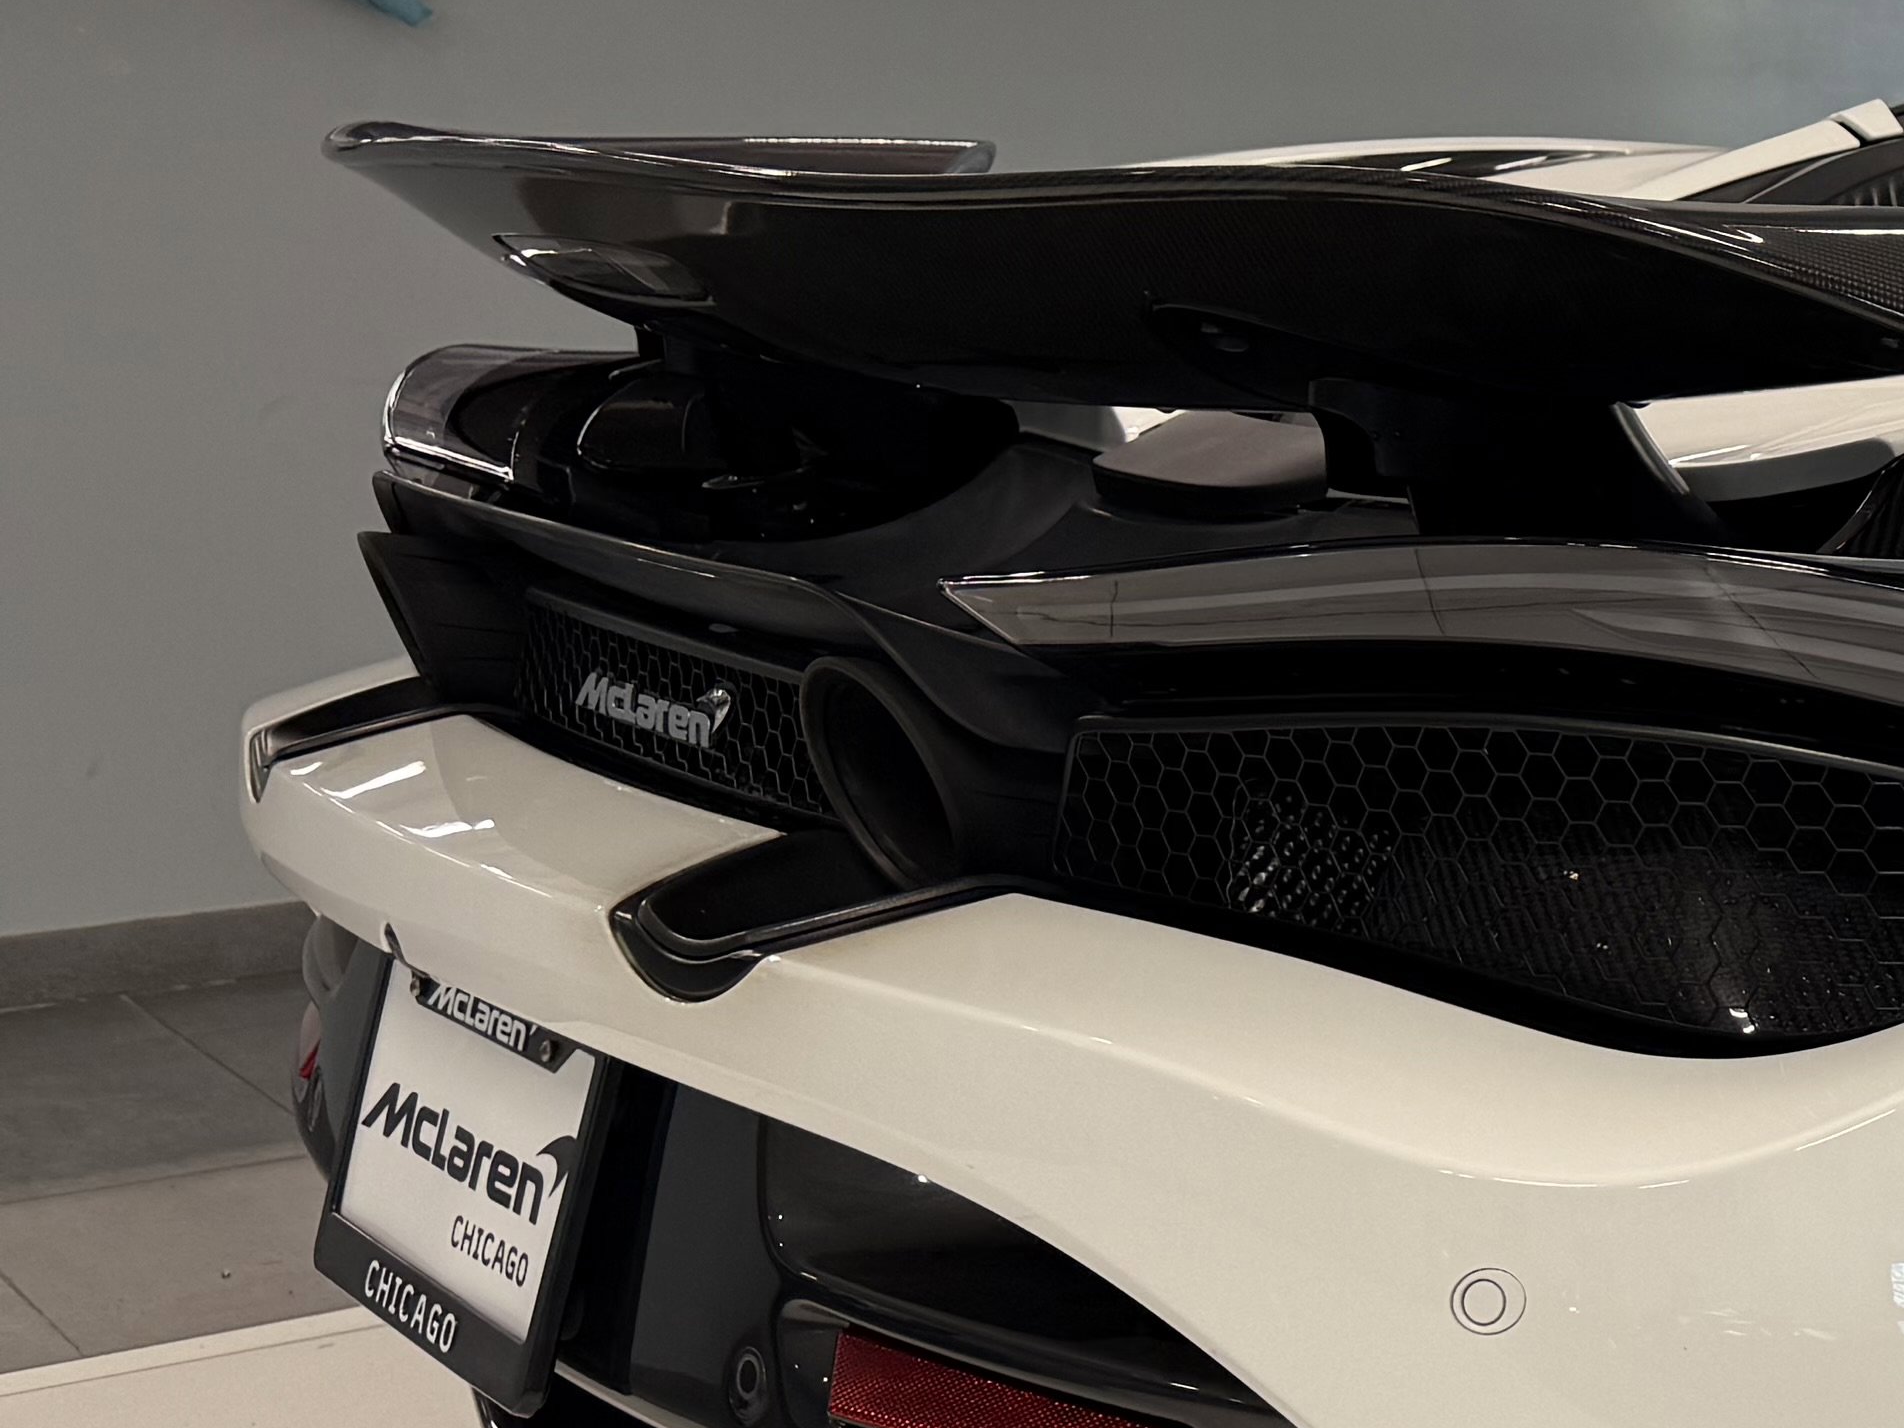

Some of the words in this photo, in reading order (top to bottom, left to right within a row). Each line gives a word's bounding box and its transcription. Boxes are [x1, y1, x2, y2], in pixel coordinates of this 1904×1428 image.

[576, 672, 712, 749] McLaren
[428, 982, 530, 1052] McLaren
[361, 1082, 544, 1225] McLaren
[450, 1215, 529, 1288] CHICAGO
[364, 1259, 456, 1354] CHICAGO
